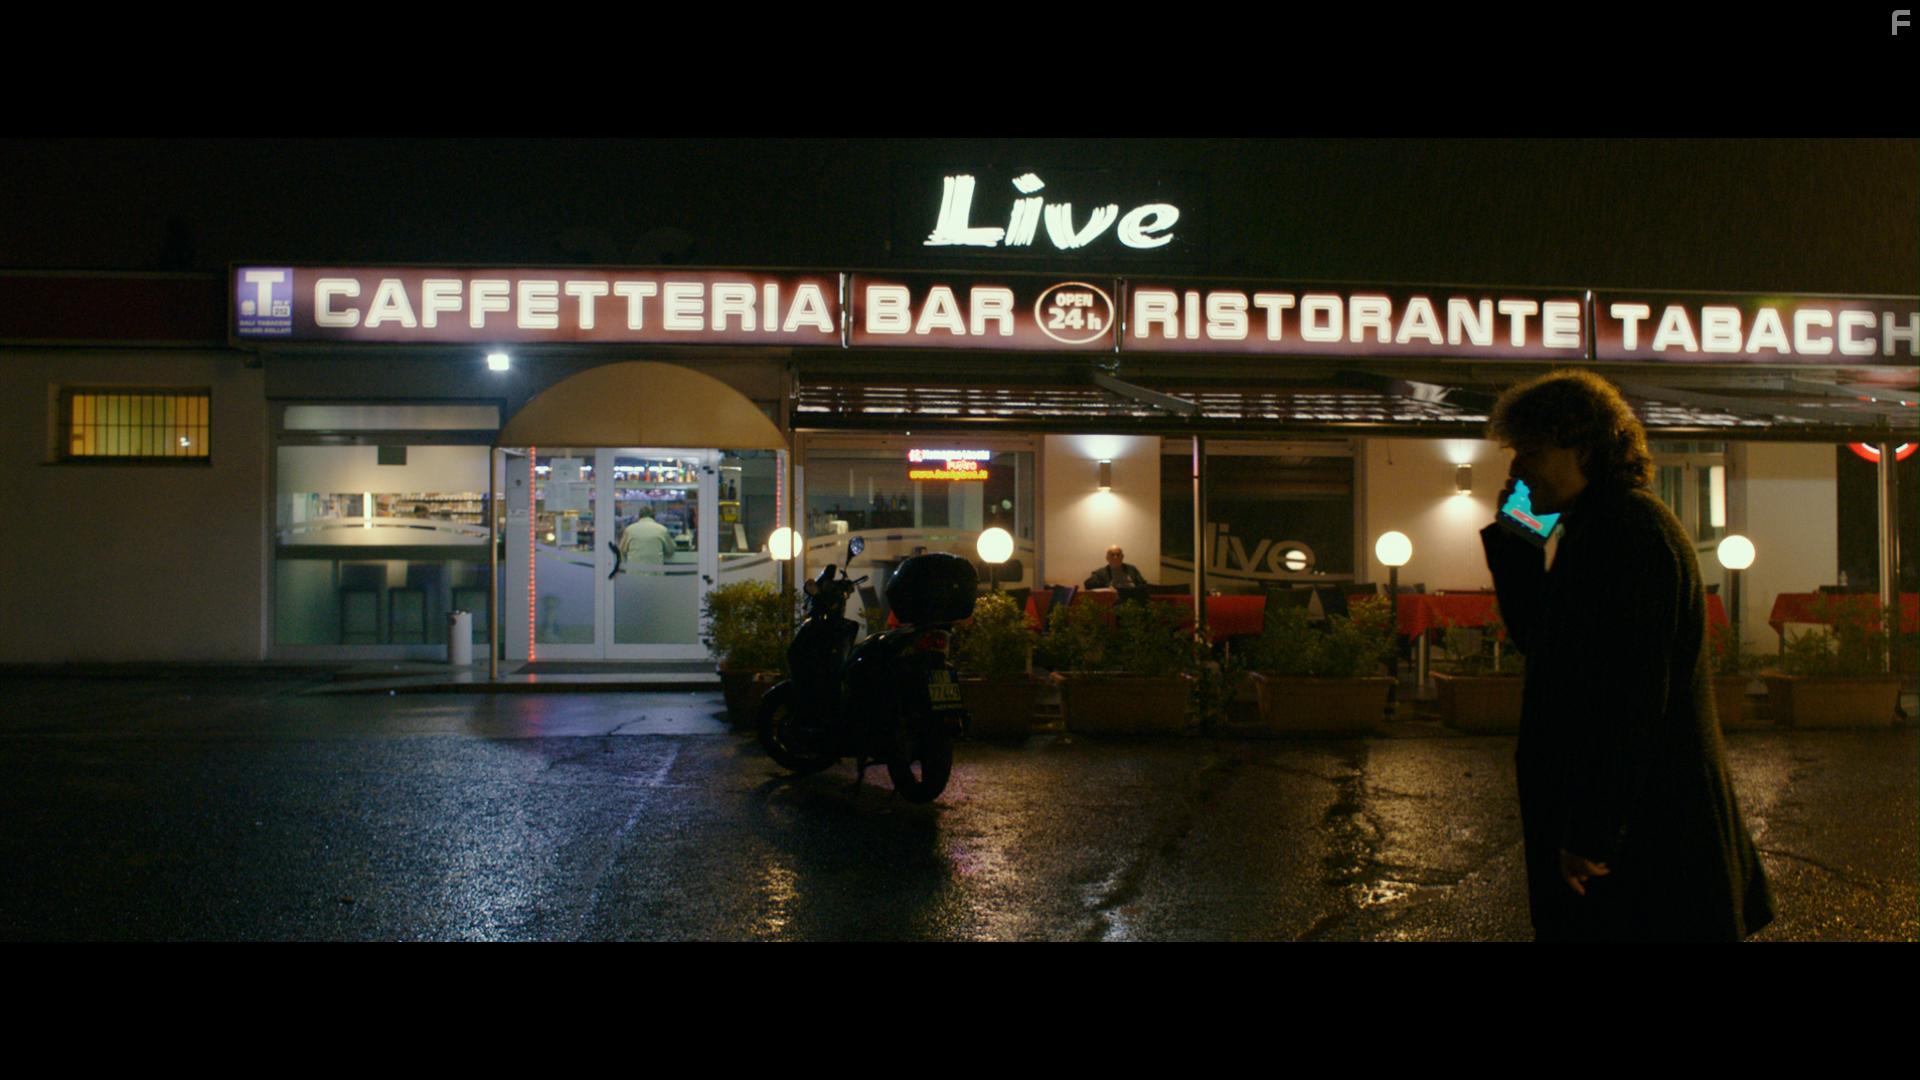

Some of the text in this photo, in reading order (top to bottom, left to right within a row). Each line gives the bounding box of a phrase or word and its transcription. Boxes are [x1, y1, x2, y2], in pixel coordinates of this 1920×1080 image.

[923, 172, 1180, 249] Live
[314, 277, 835, 333] CAFFETTERIA
[865, 285, 1015, 336] BAR
[1055, 292, 1094, 308] OPEN
[1133, 290, 1581, 349] RISTORANTE
[1610, 303, 1920, 357] TABACCH
[1204, 522, 1316, 576] live
